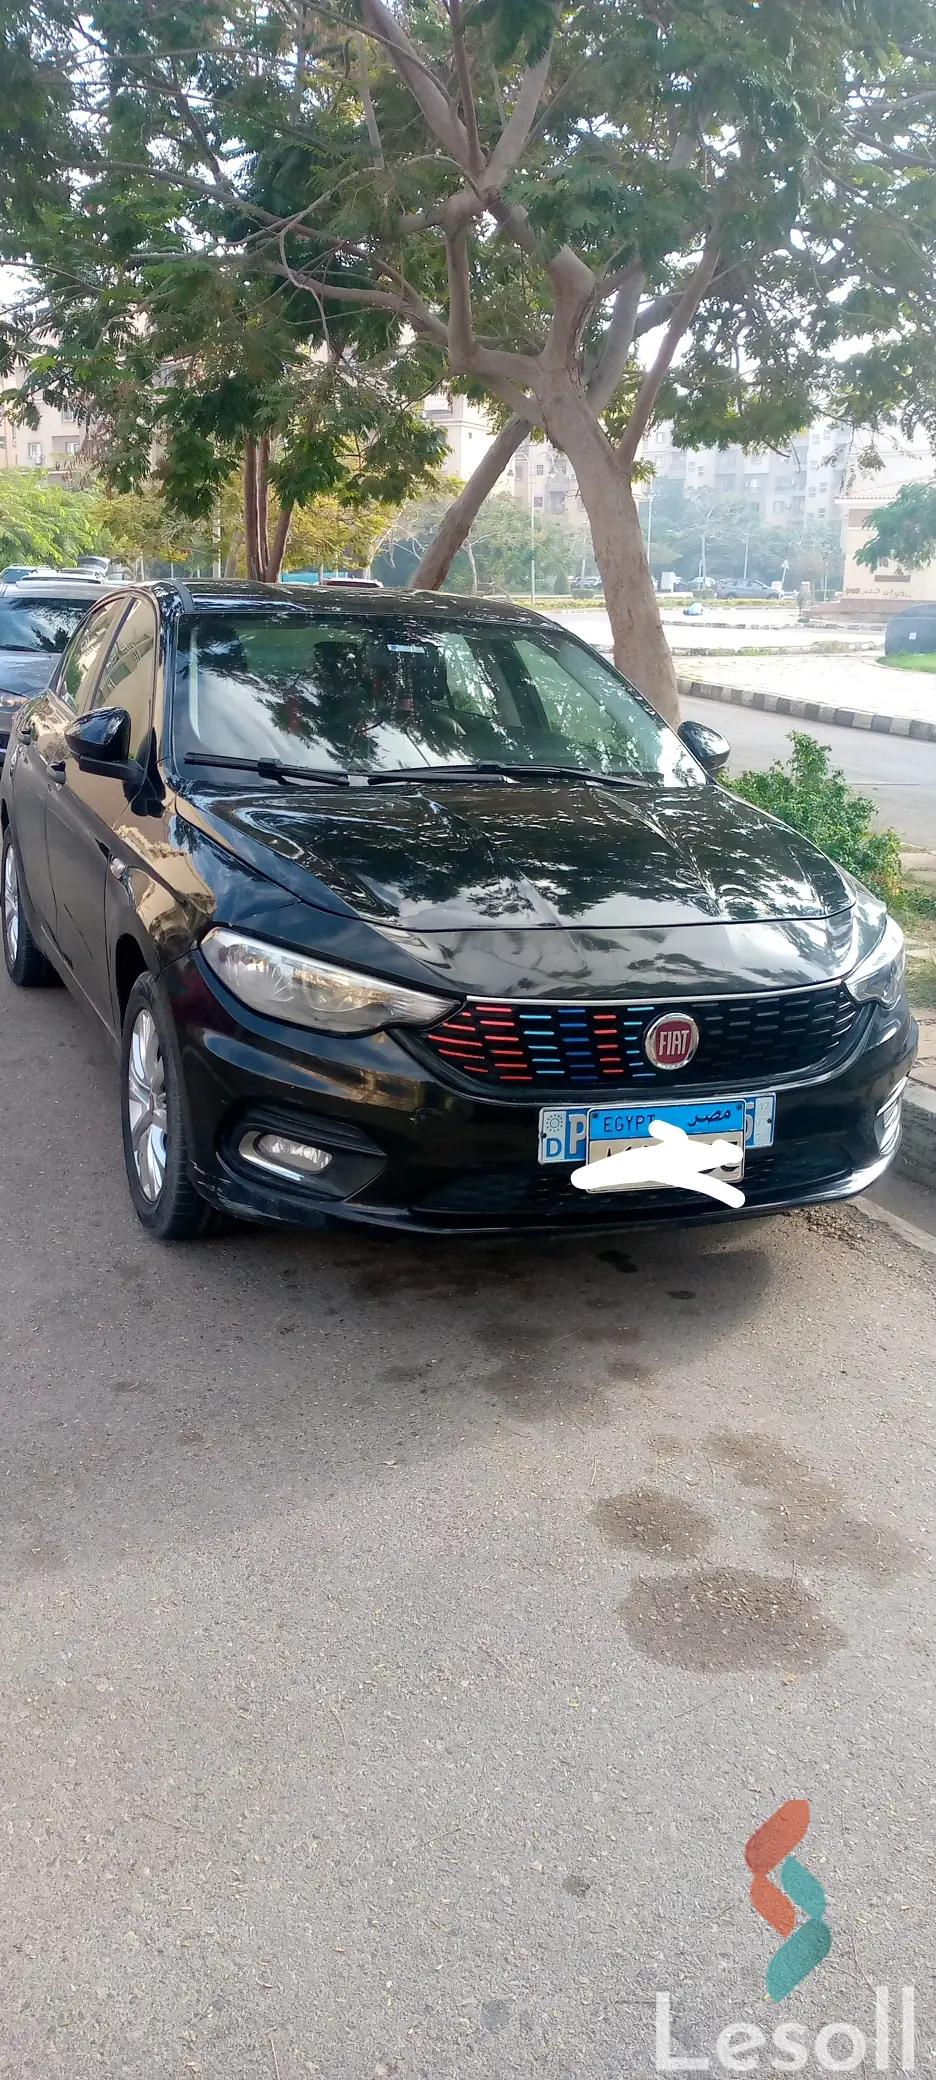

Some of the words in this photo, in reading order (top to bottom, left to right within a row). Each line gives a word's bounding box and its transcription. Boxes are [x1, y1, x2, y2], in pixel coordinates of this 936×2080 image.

[658, 1030, 690, 1056] FIAT
[603, 1114, 656, 1133] EGYPT
[687, 1109, 732, 1127] مصر
[545, 1137, 563, 1158] D
